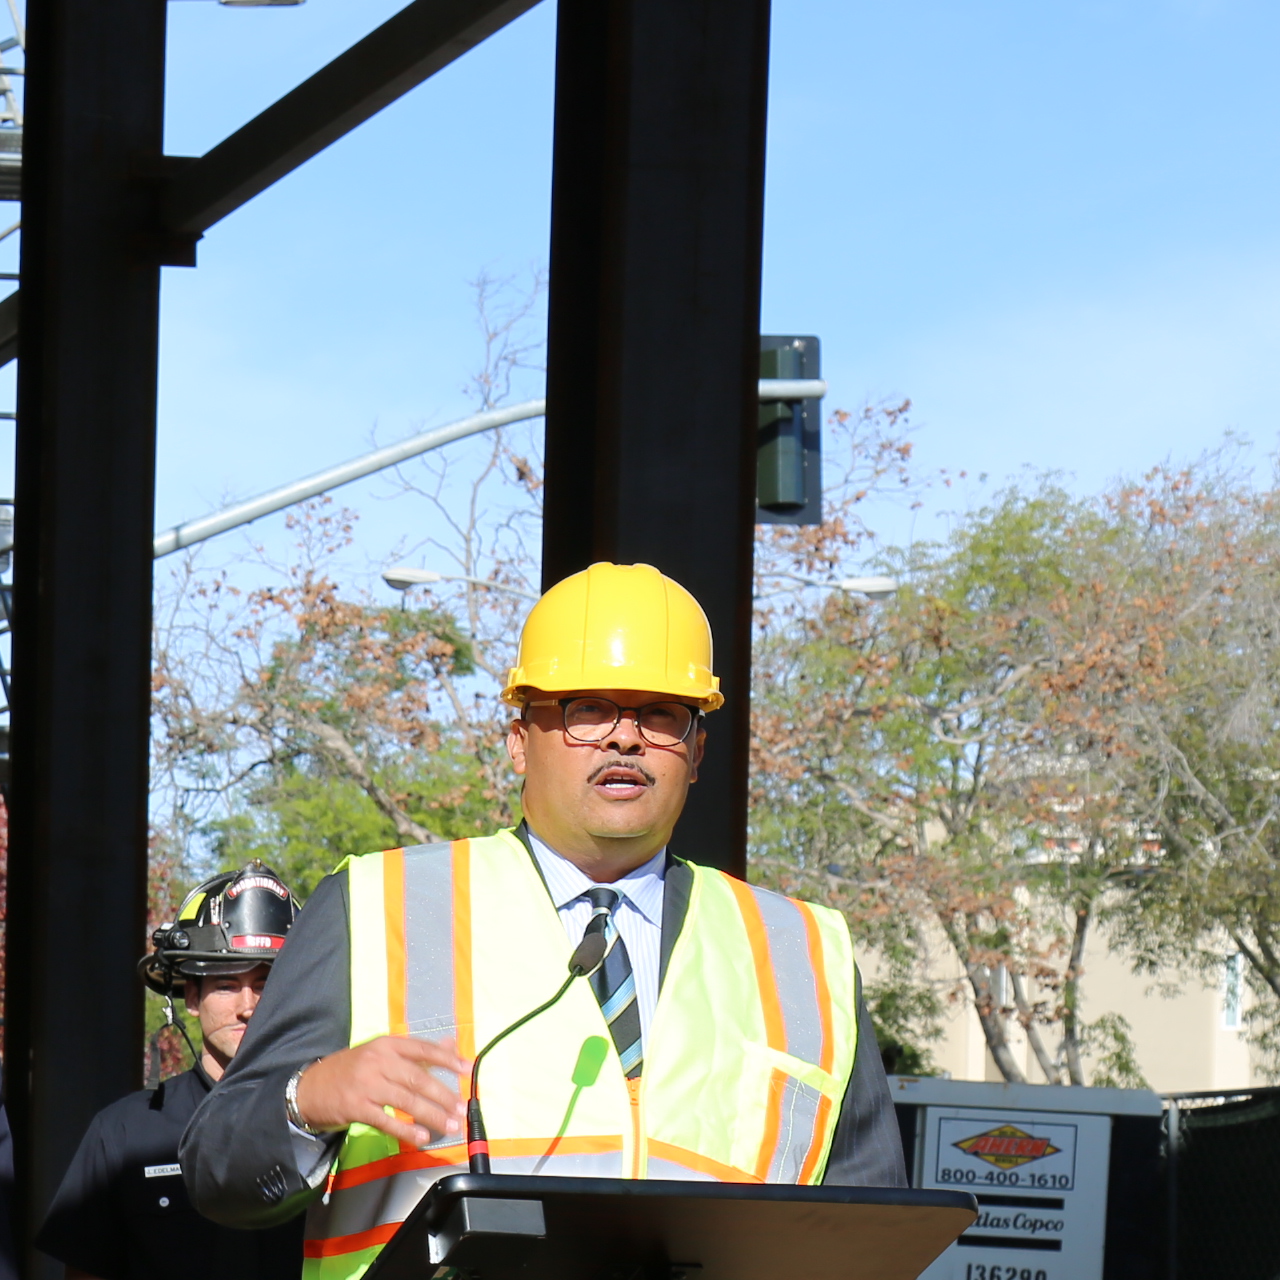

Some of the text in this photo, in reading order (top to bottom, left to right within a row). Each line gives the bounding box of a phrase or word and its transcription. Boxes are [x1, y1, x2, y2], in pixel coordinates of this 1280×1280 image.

[232, 876, 286, 897] PROBATIONARY
[246, 934, 272, 948] SFFD
[966, 1136, 1051, 1158] AHERN
[153, 1166, 180, 1175] EDELMA
[941, 1167, 1070, 1188] 800-400-1610
[970, 1211, 1065, 1235] tlas Copco
